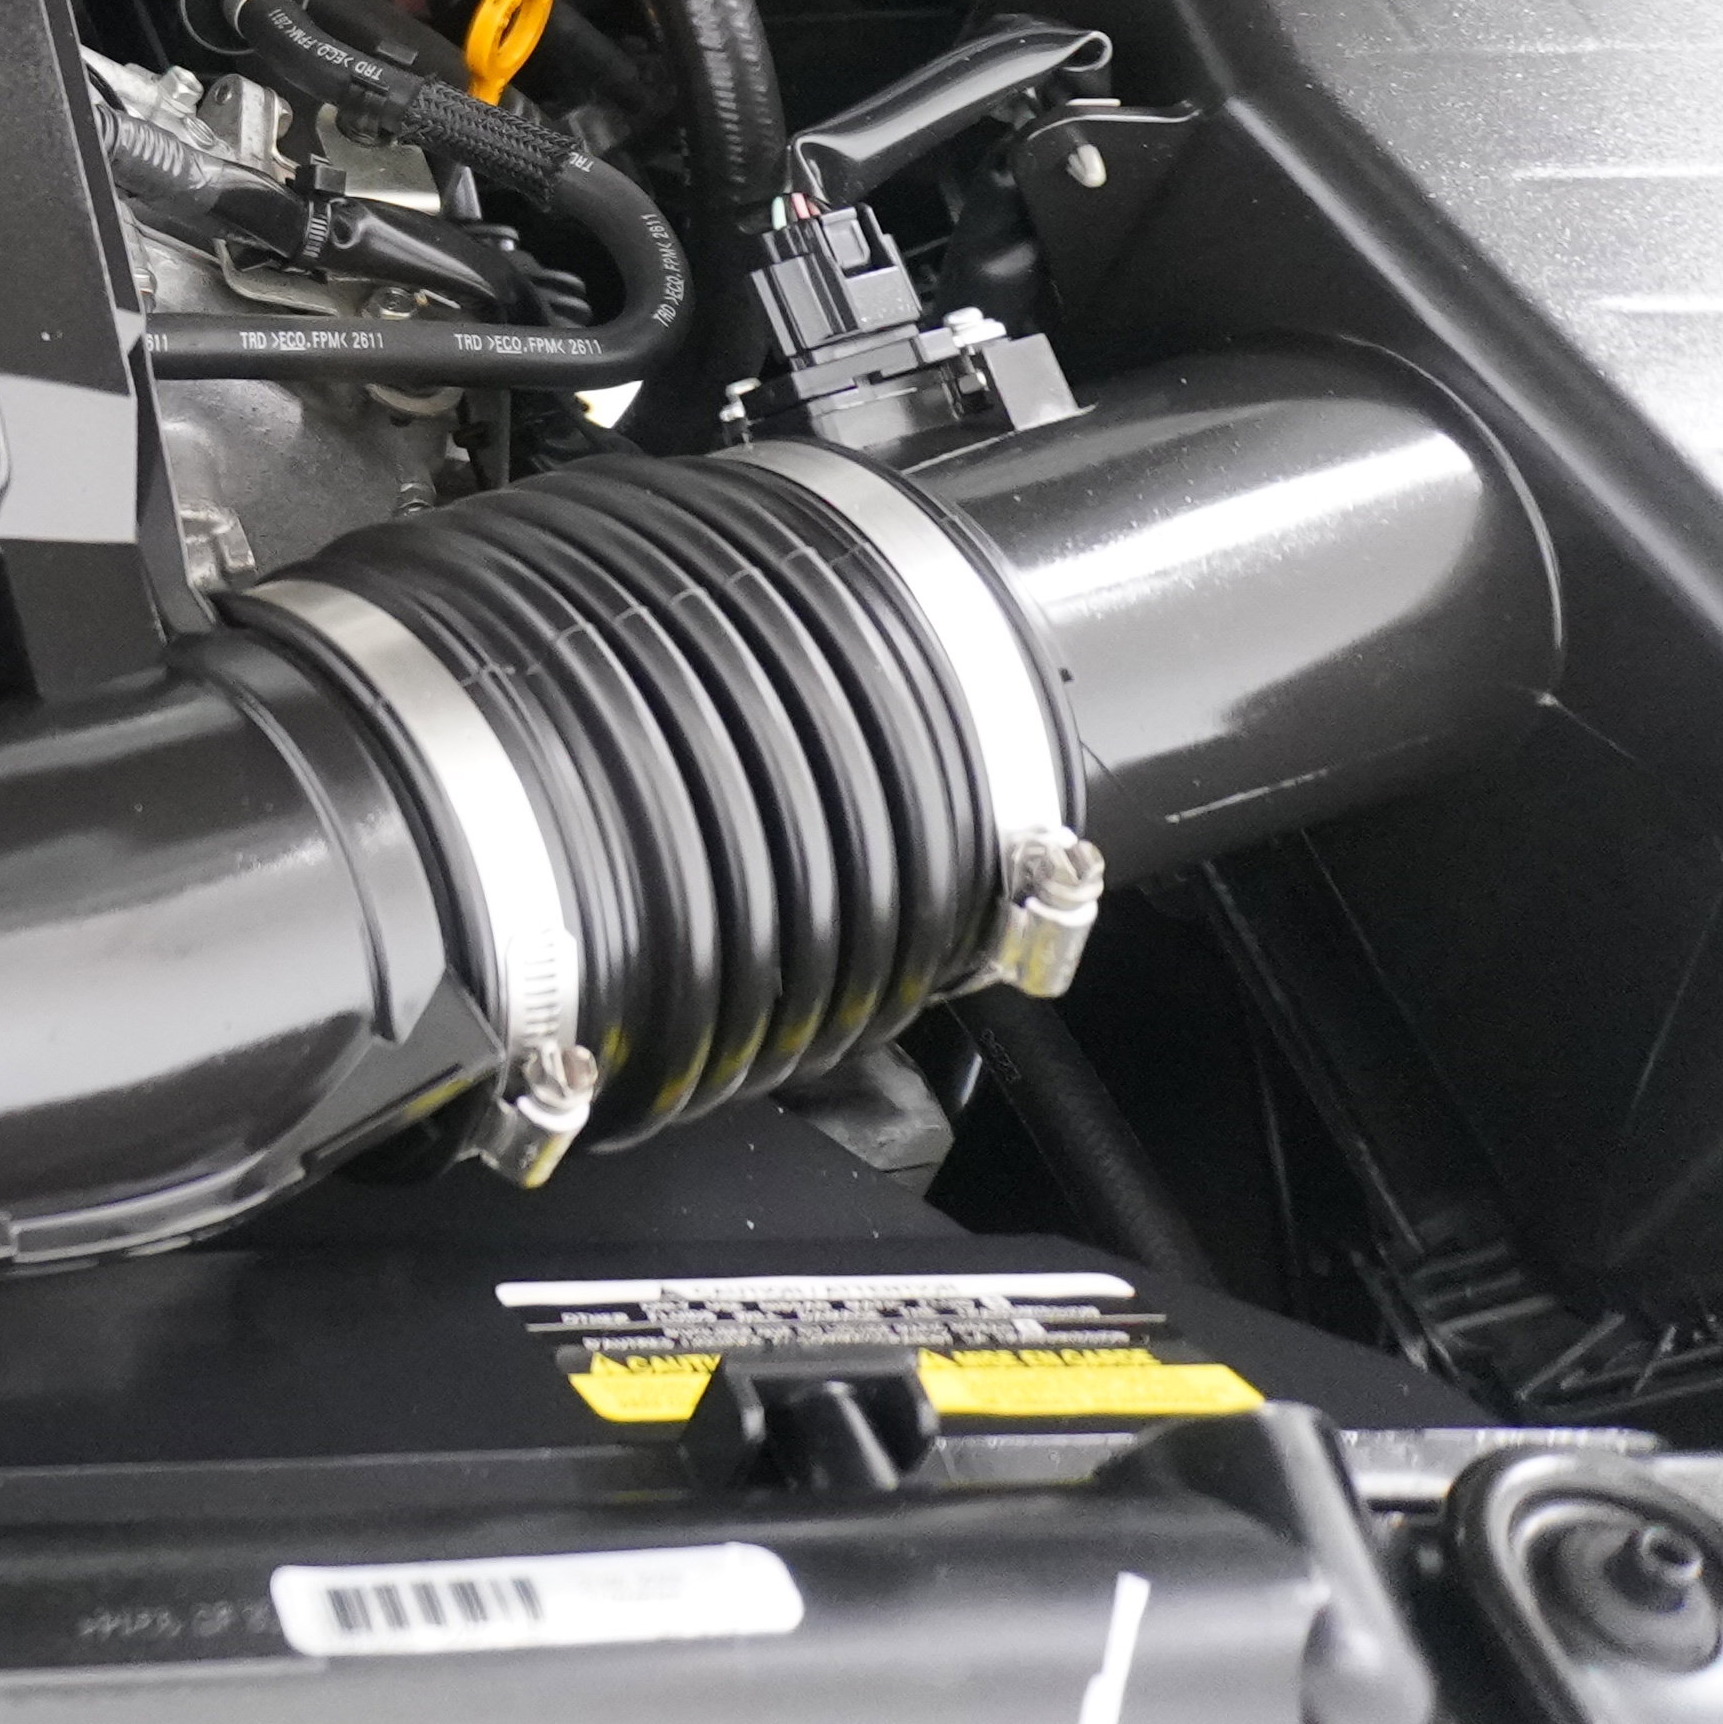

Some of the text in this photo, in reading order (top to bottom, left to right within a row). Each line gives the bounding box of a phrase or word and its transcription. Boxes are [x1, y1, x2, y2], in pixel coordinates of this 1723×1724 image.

[354, 61, 384, 81] TRD
[641, 213, 670, 240] 2611
[652, 303, 677, 328] TRD
[239, 330, 385, 352] TRD >ECO.FPM< 2611
[454, 333, 603, 356] TRD >ECO.FPM< 2611
